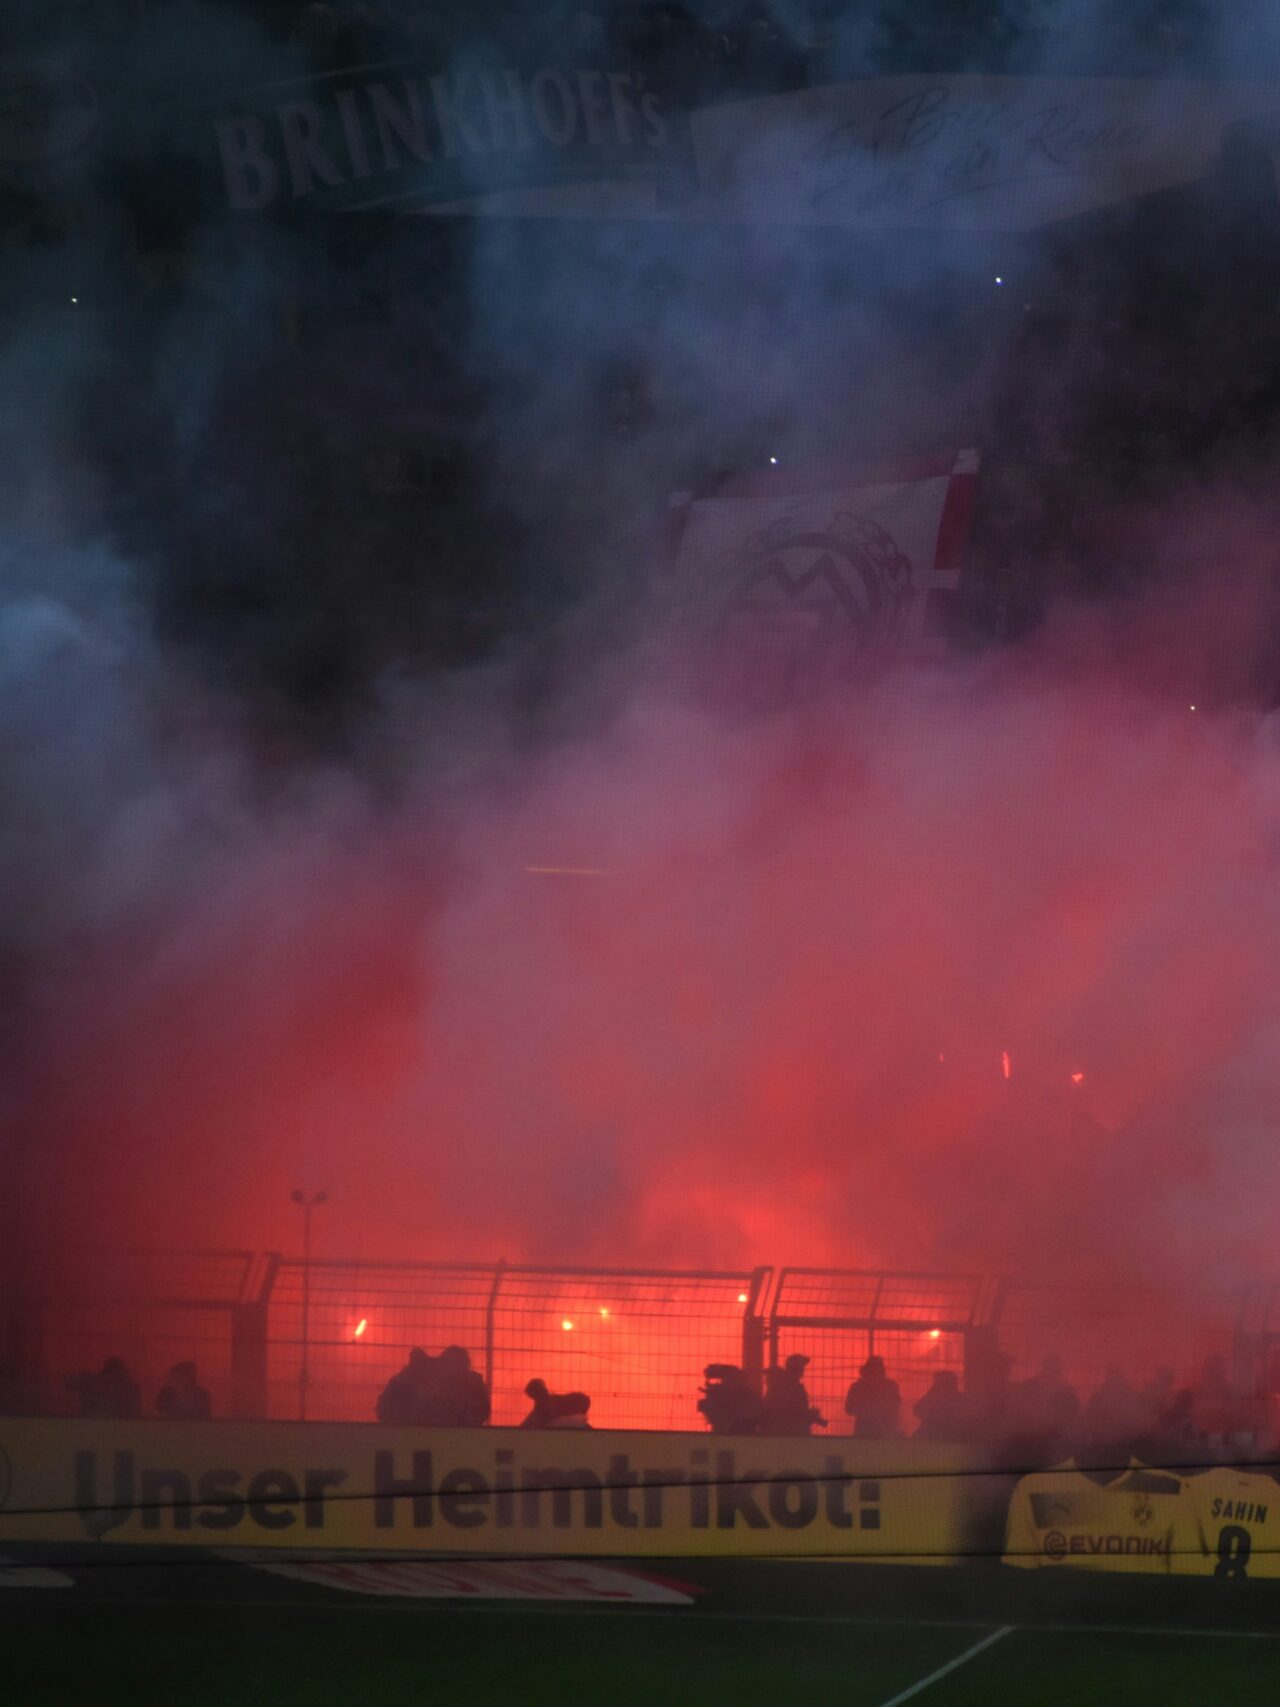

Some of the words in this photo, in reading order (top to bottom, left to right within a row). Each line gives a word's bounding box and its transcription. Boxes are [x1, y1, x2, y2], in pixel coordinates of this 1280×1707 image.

[75, 1449, 349, 1530] Unser
[374, 1449, 880, 1530] Heimtrikot:
[1211, 1498, 1268, 1524] SAHIN
[1214, 1525, 1251, 1579] 8
